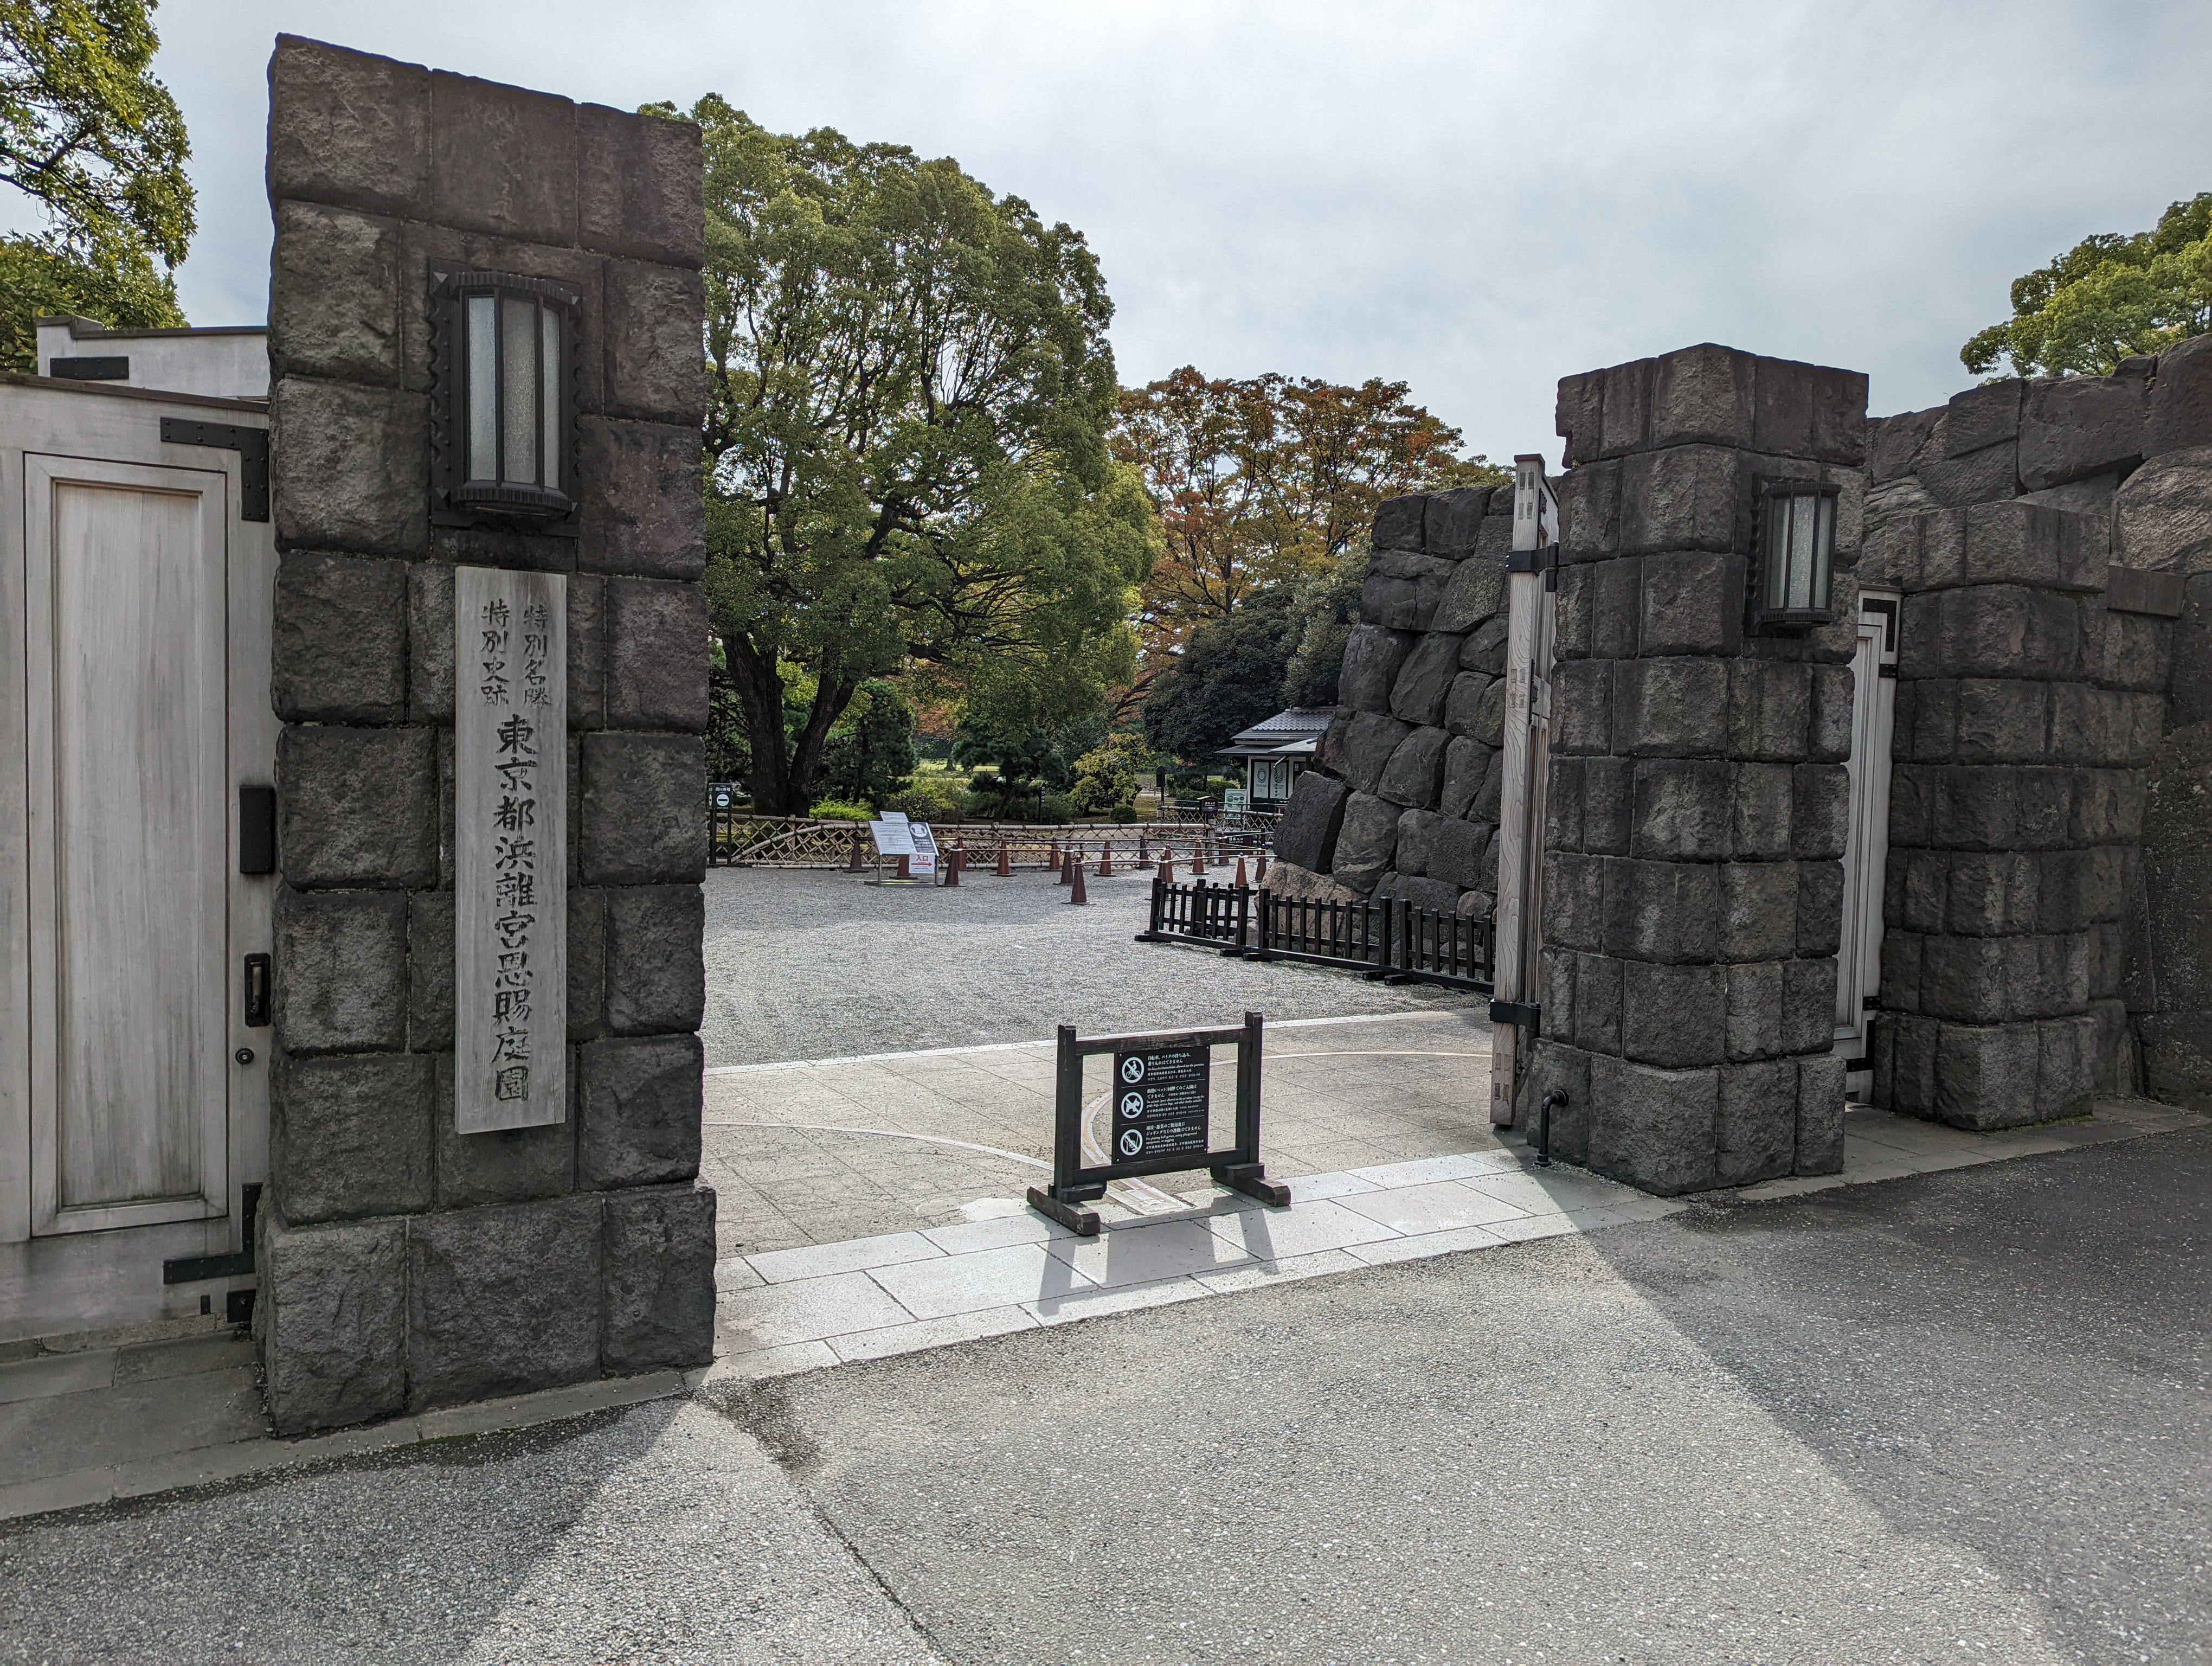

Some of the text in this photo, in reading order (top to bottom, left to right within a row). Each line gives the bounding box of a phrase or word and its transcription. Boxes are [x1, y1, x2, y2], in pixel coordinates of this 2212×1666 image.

[479, 598, 510, 707] 特別史跡
[523, 603, 551, 709] 特別名勝
